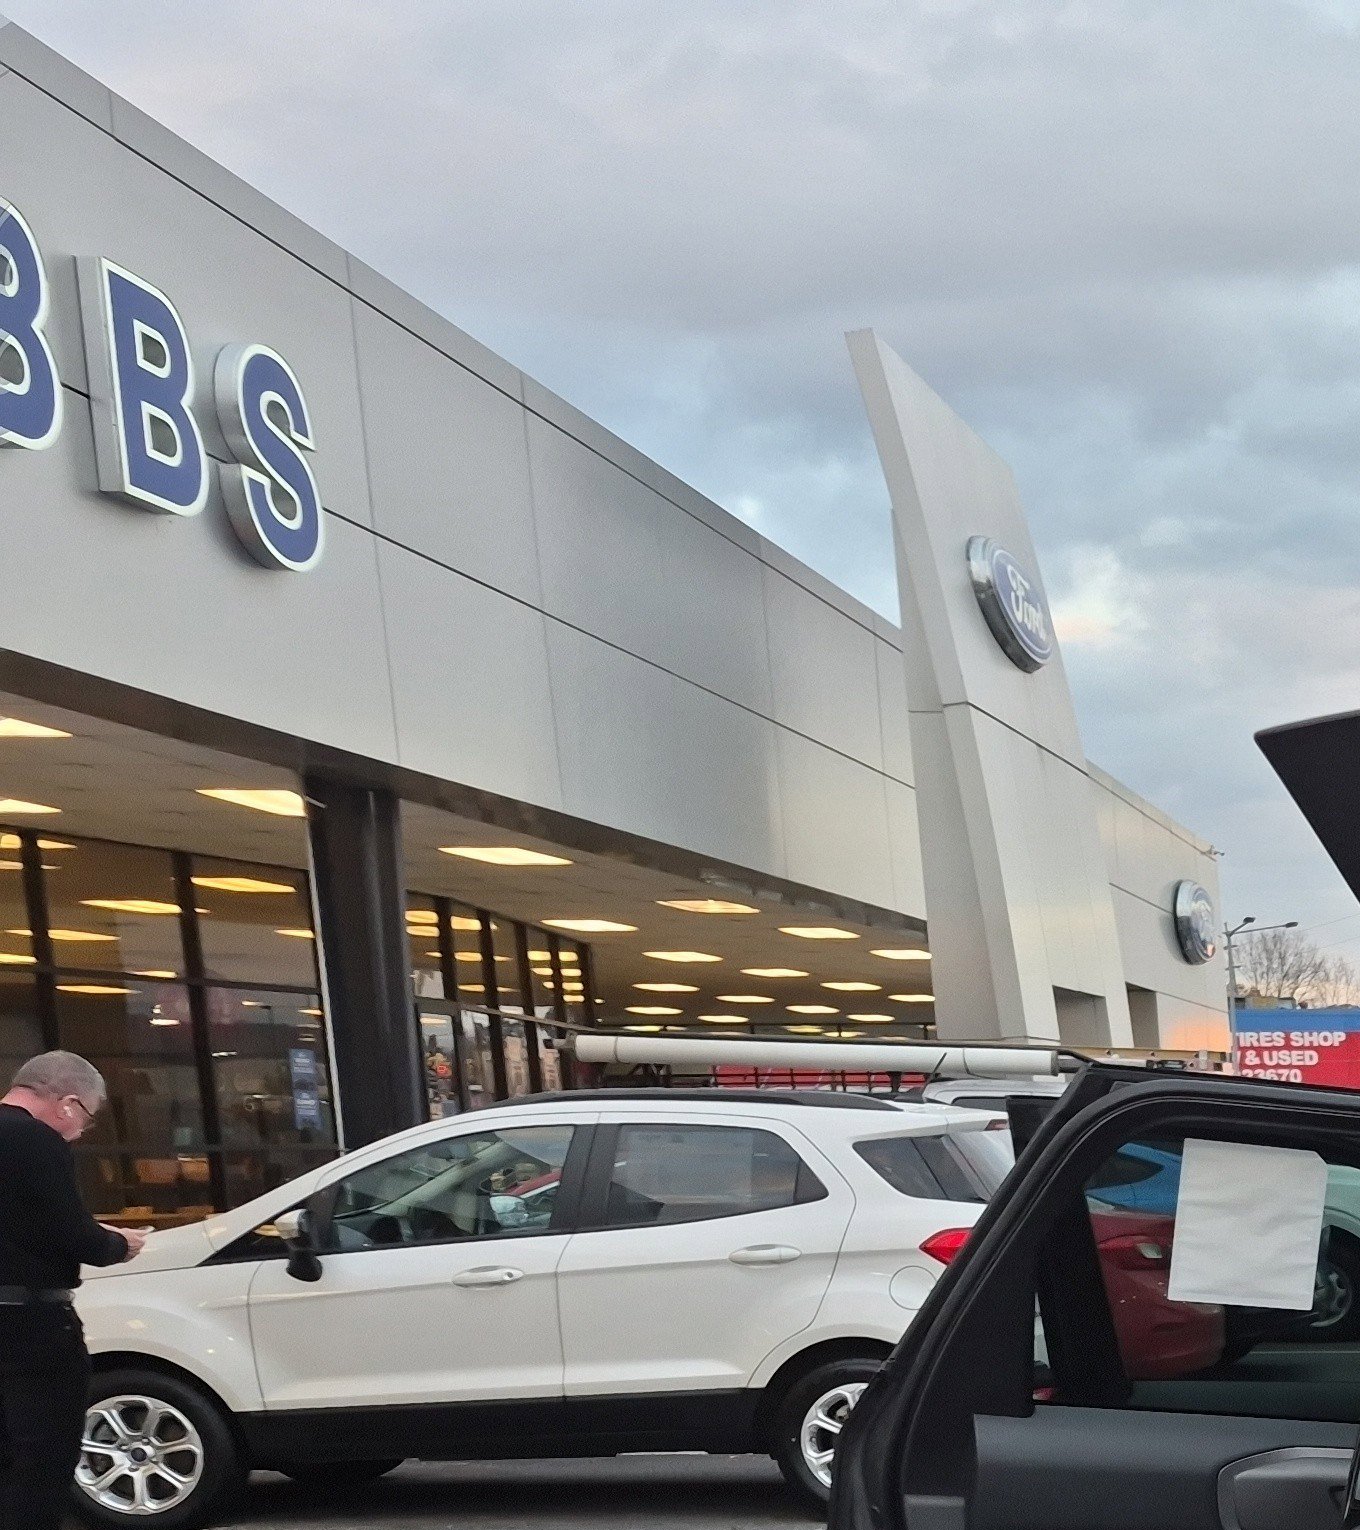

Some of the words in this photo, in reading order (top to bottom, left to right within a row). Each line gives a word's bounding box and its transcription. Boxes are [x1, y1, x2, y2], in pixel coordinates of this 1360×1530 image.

[1006, 564, 1046, 641] Ford
[1290, 1031, 1346, 1047] SHOP
[1245, 1049, 1261, 1066] &
[1262, 1050, 1319, 1066] USED
